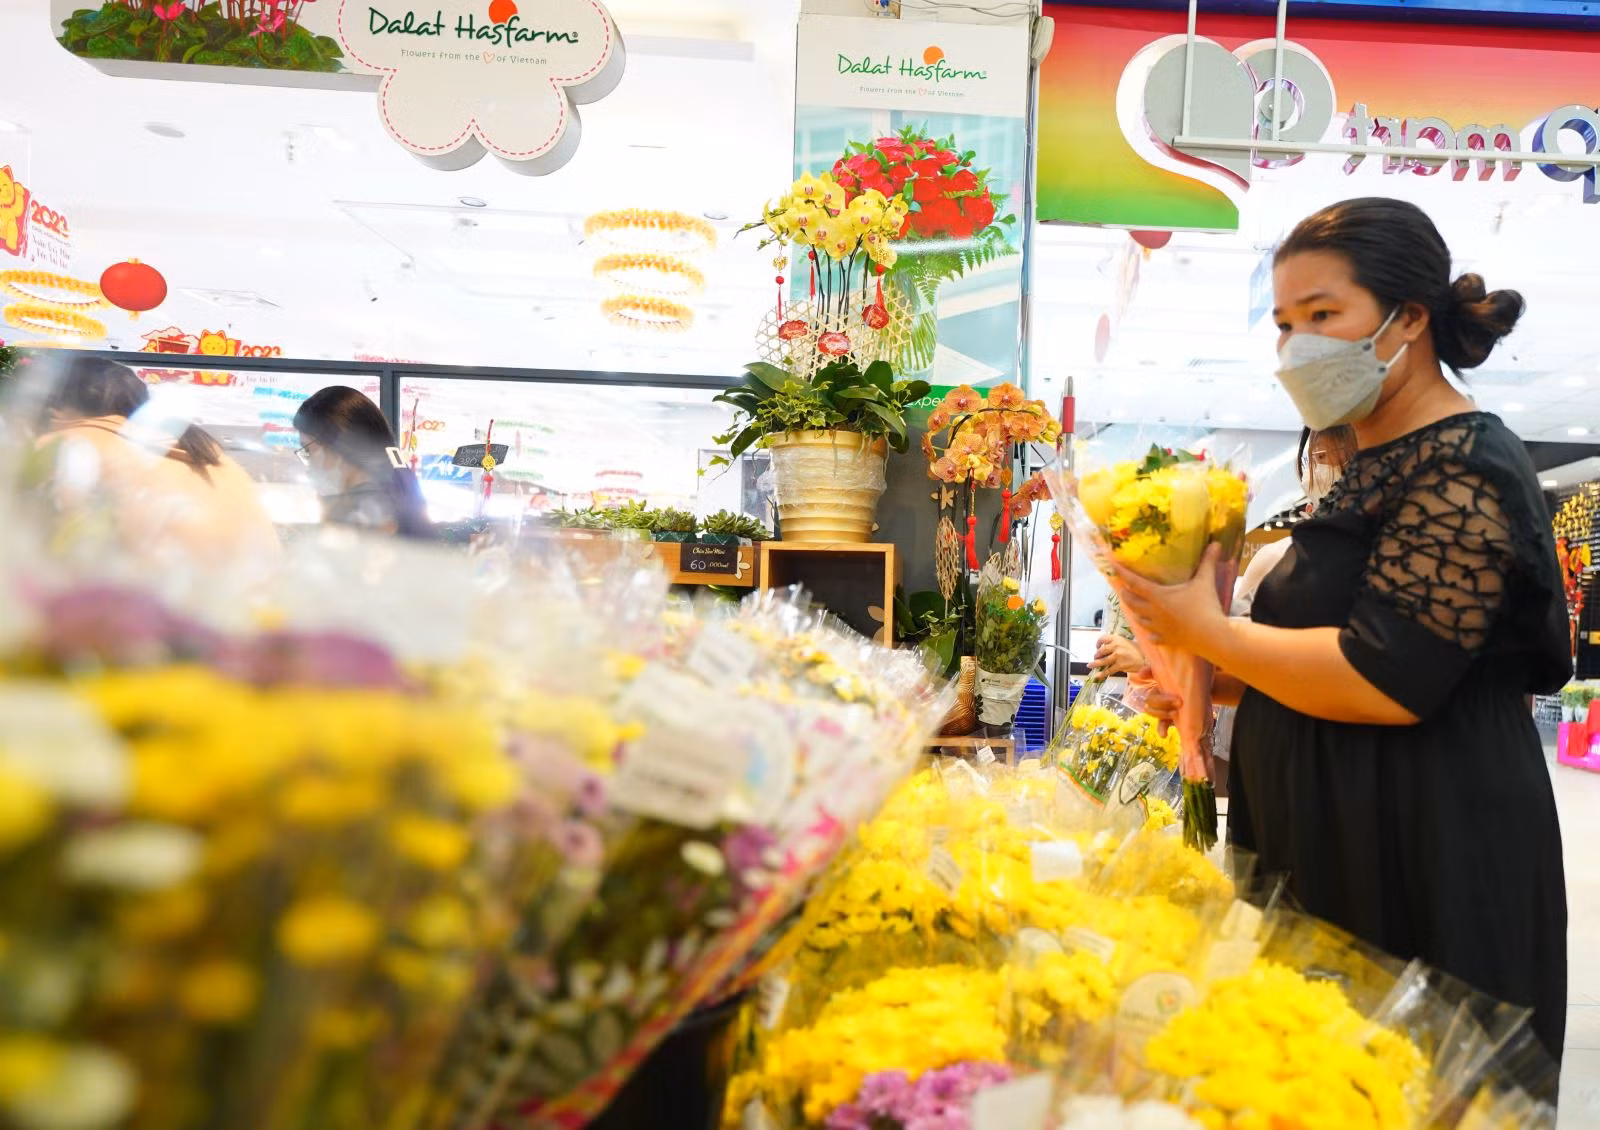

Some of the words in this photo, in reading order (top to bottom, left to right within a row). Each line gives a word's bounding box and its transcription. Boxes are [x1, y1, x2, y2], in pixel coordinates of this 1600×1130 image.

[368, 7, 446, 35] Dalat
[401, 49, 436, 59] Flowers
[439, 51, 461, 61] from
[464, 53, 480, 61] the
[496, 55, 507, 63] of
[510, 56, 547, 65] Vietnam
[837, 53, 893, 75] Dalat
[690, 559, 707, 570] 60
